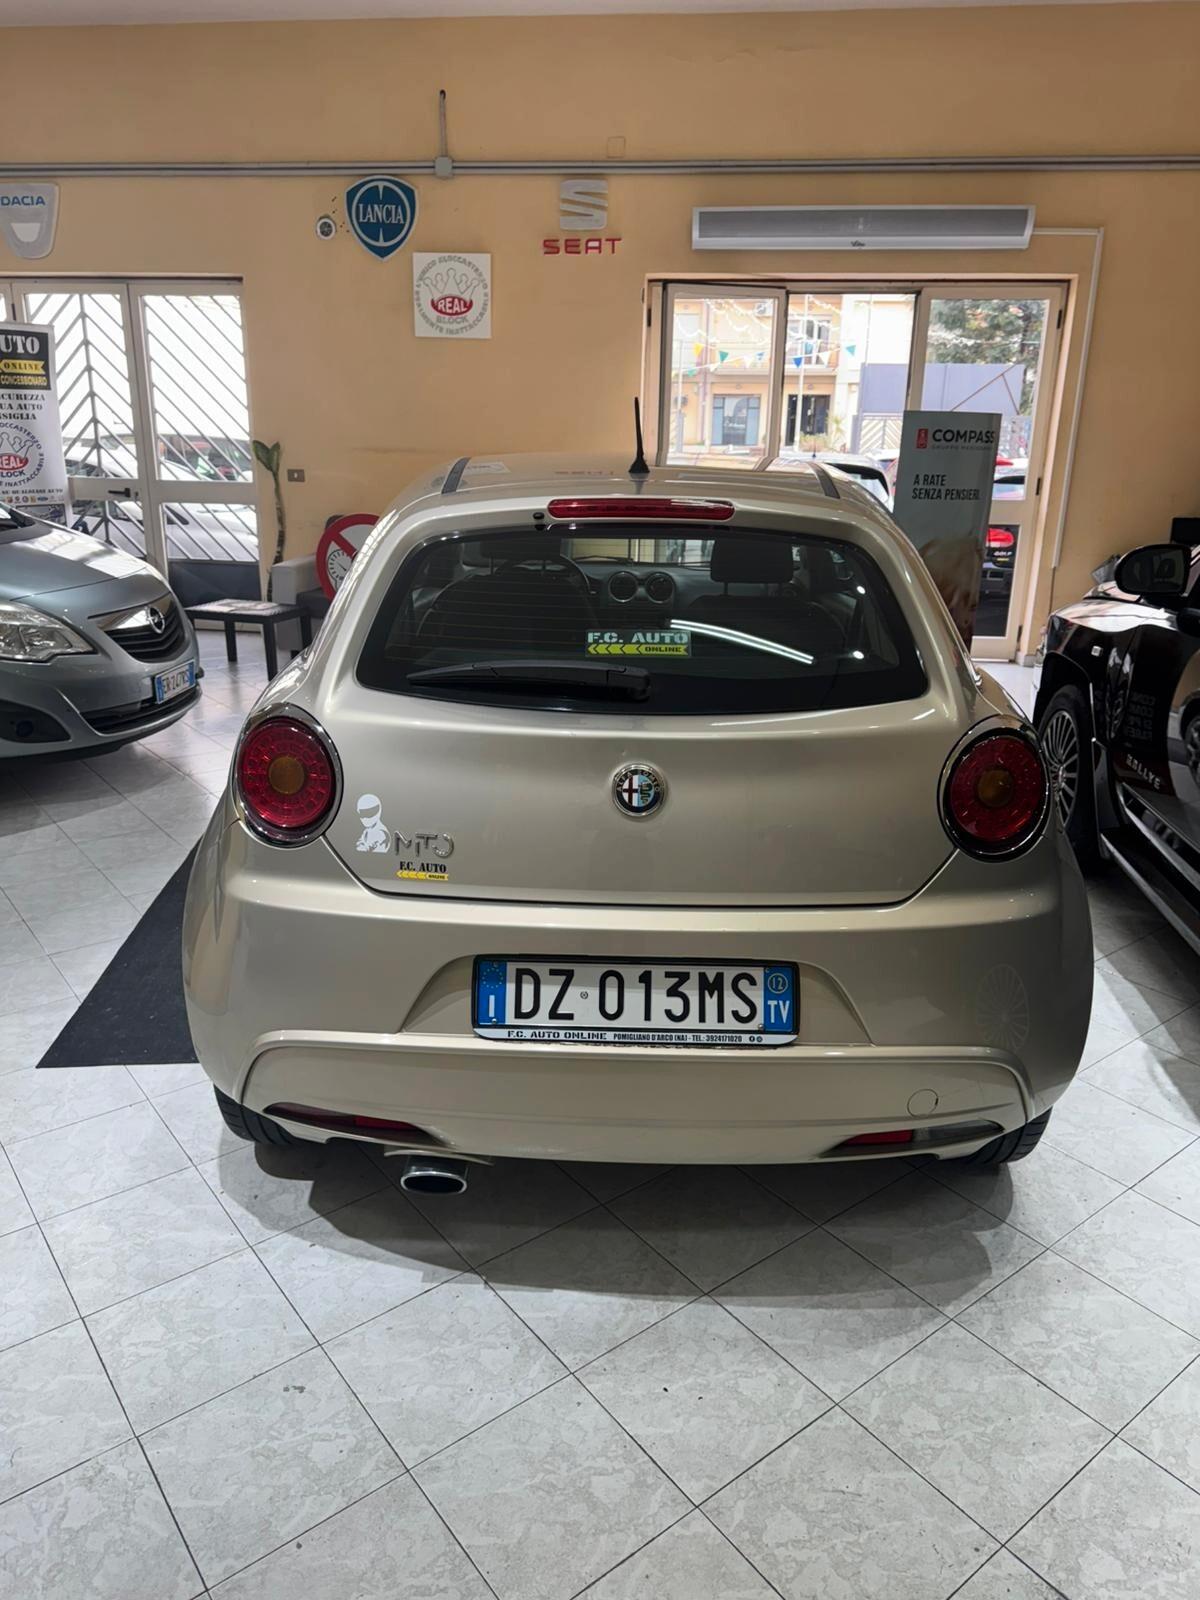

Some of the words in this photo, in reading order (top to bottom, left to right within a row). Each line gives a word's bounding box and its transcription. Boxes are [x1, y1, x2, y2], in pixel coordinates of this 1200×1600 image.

[1, 195, 46, 206] DACIA
[358, 203, 404, 224] LANCIA
[543, 238, 622, 255] SEAT
[437, 297, 469, 314] REAL
[4, 362, 39, 371] ONLINE
[913, 474, 920, 485] A
[922, 474, 947, 486] RATE
[912, 488, 942, 500] SENZA
[587, 632, 623, 643] F.C.
[631, 632, 688, 643] AUTO
[644, 645, 682, 653] ONLINE
[419, 863, 447, 873] AUTO
[772, 977, 784, 990] 12
[514, 968, 574, 1020] DZ
[599, 969, 758, 1024] 013MS
[767, 1000, 790, 1024] TV
[507, 1030, 527, 1038] F.C.
[530, 1031, 560, 1039] AUTO
[563, 1031, 607, 1040] ONLINE
[613, 1033, 651, 1041] POMIGLIANO
[651, 1034, 674, 1042] D'ARCO
